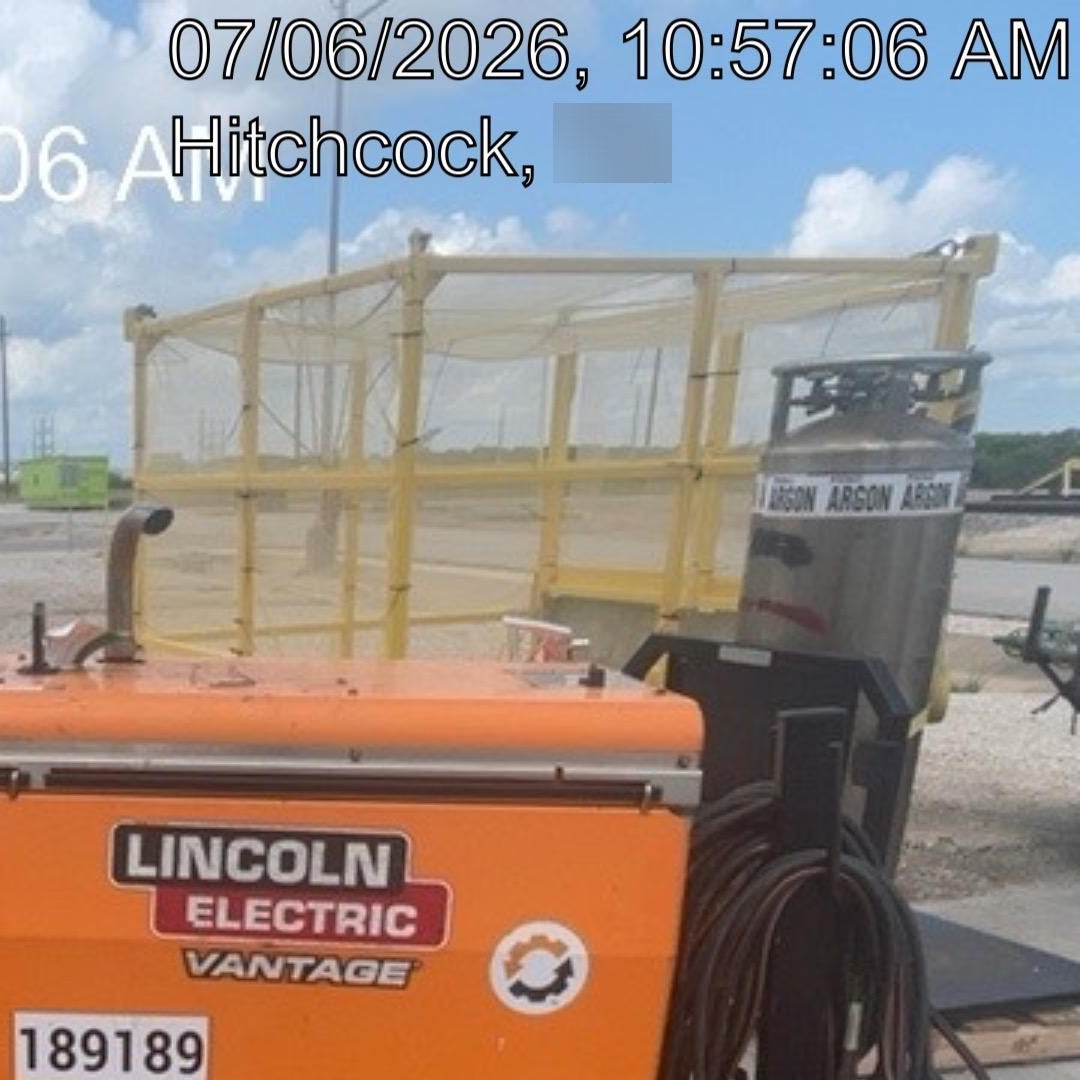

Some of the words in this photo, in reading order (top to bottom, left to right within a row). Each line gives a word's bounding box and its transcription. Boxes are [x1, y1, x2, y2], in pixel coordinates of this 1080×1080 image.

[827, 484, 894, 512] ARGON
[126, 833, 391, 888] LINCOLN
[186, 895, 419, 938] ELECTRIC
[182, 949, 414, 988] VANTAGE
[19, 1026, 204, 1075] 189189
